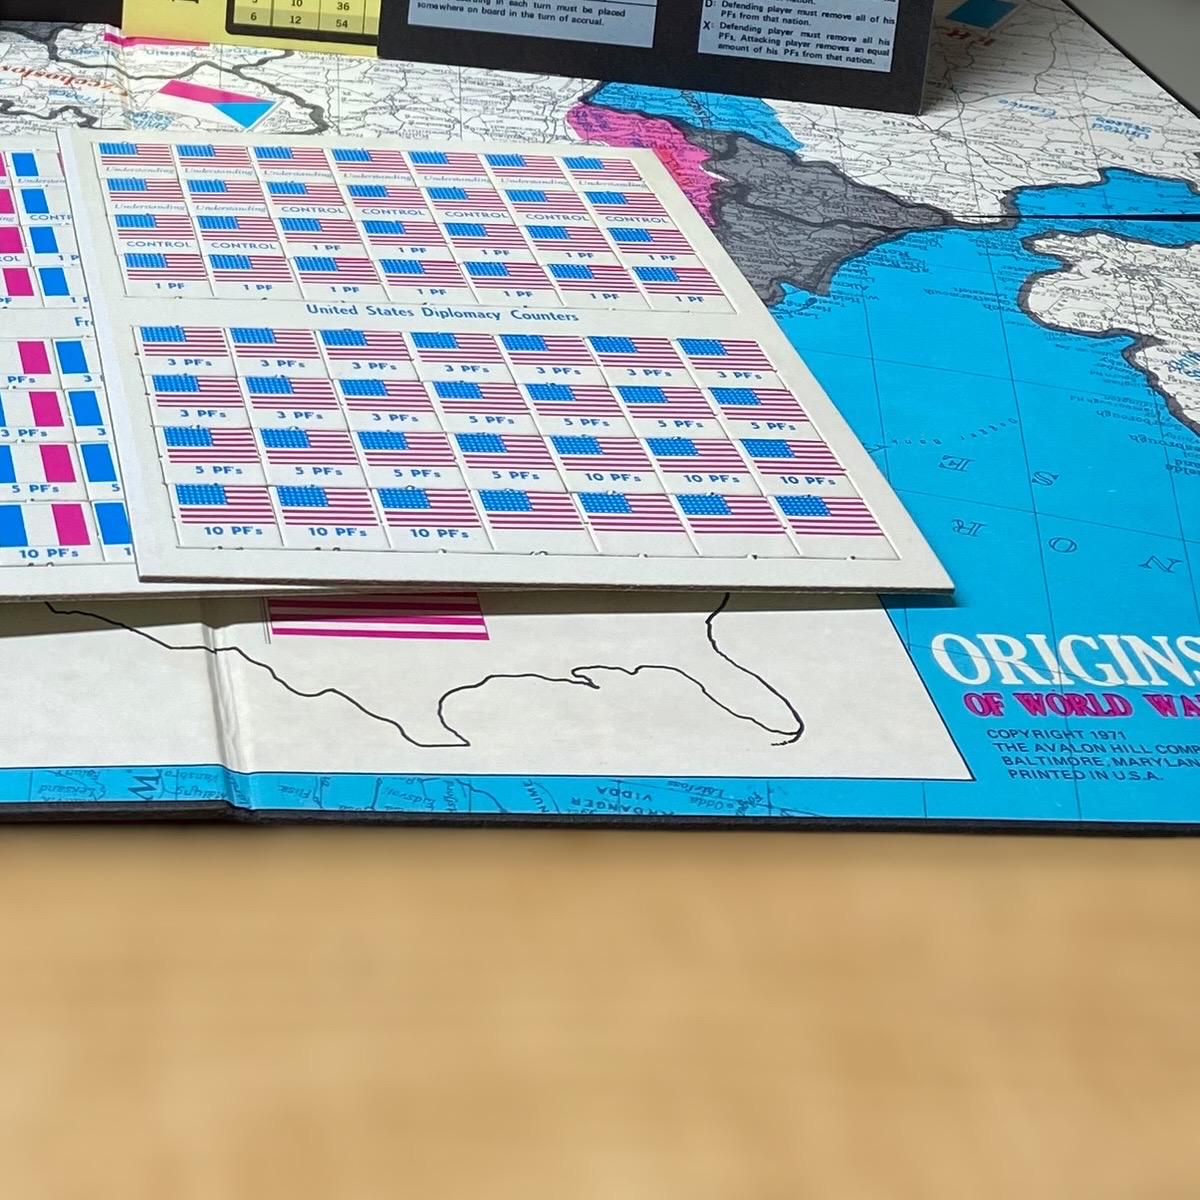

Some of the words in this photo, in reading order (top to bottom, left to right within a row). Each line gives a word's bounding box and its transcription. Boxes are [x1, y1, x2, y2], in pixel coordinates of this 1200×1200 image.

[306, 303, 358, 315] United
[365, 305, 414, 316] States
[421, 306, 500, 321] Diplomacy
[510, 309, 579, 321] Counters
[963, 692, 1005, 717] OF
[1013, 692, 1134, 717] WORLD
[1142, 694, 1200, 717] WA
[987, 729, 1084, 740] COPYRIGHT
[1090, 730, 1127, 740] 1971
[993, 742, 1028, 752] THE
[1034, 743, 1107, 753] AVALON
[1113, 743, 1152, 754] HILL
[1155, 744, 1200, 755] COMP
[1113, 757, 1200, 767] MARYLAN
[1008, 769, 1086, 780] PRINTED
[1090, 770, 1109, 780] IN
[1112, 771, 1164, 781] U.S.A.
